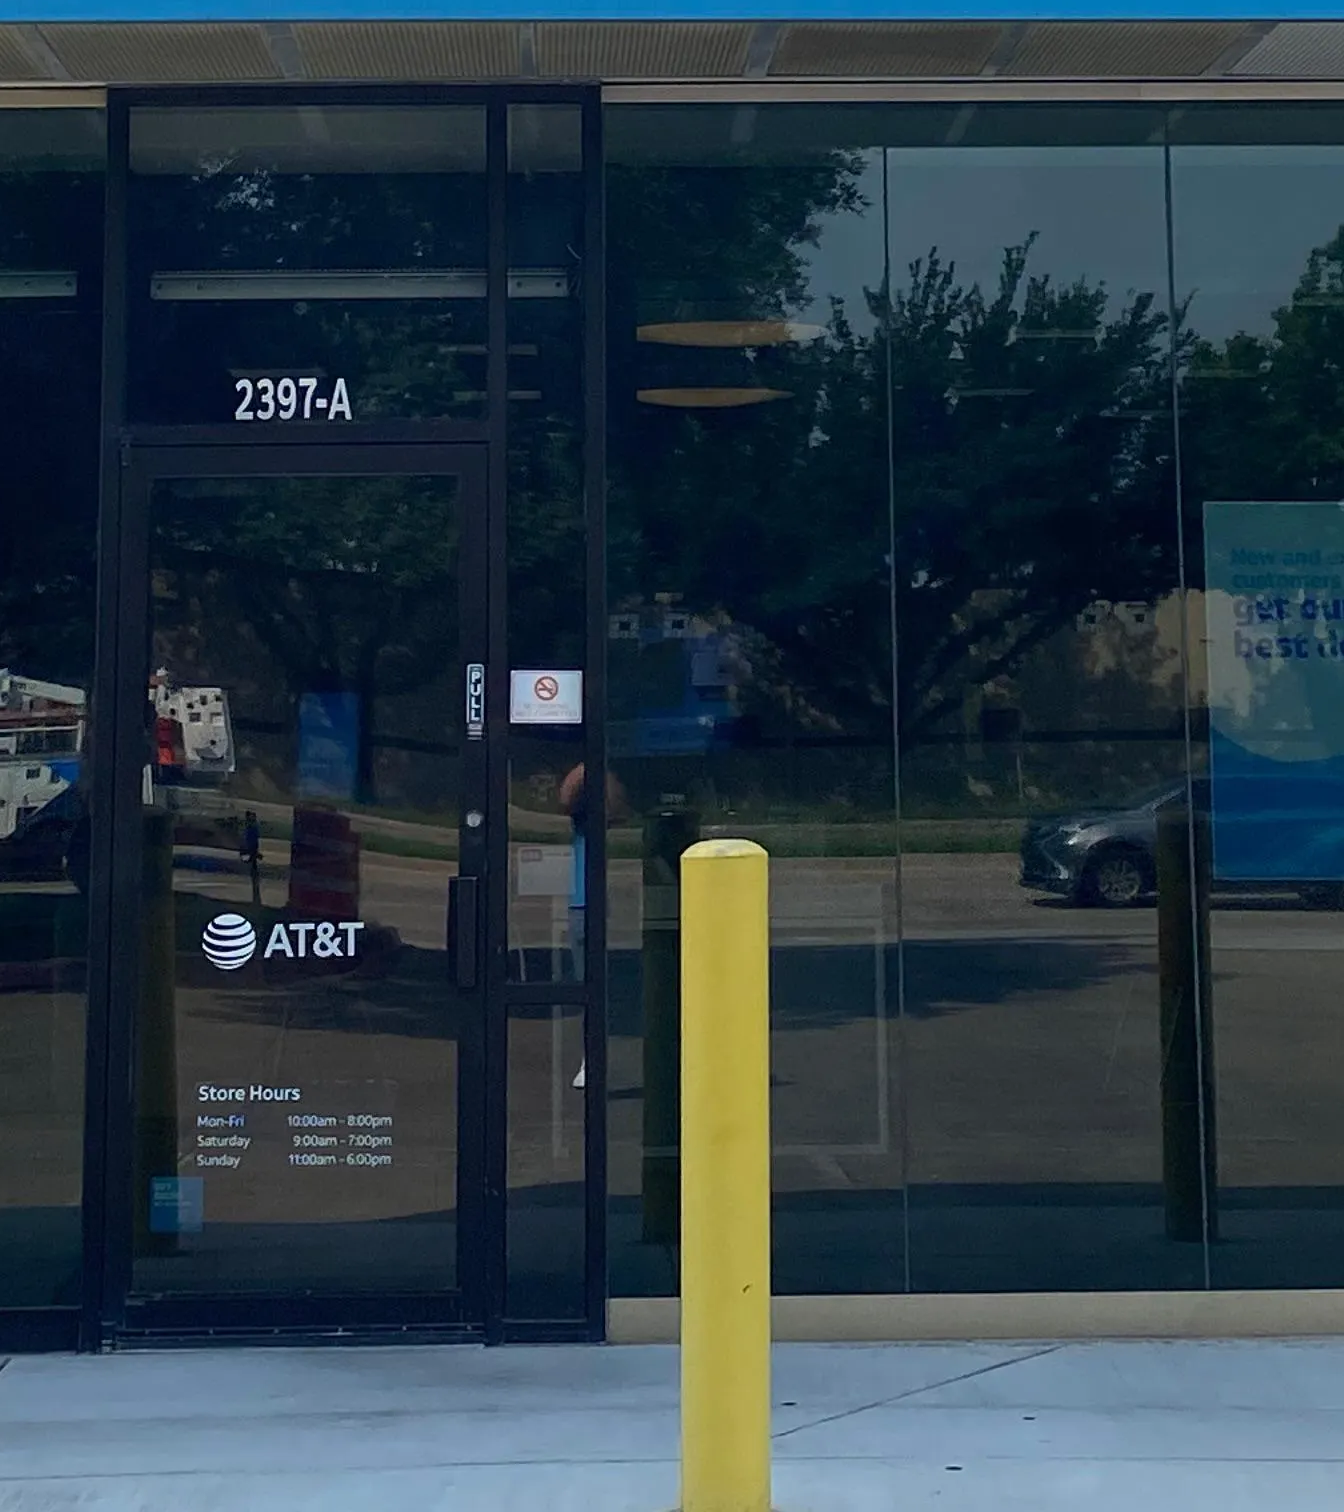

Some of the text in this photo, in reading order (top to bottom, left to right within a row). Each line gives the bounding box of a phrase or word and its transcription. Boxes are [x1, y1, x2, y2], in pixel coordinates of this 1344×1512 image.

[234, 377, 352, 421] 2397-A
[1283, 549, 1321, 566] and
[1233, 596, 1291, 626] get
[1234, 629, 1309, 659] best
[469, 670, 483, 722] PULL
[263, 921, 365, 958] AT&T
[197, 1085, 301, 1102] Store Hours
[196, 1114, 244, 1128] Mon-Fri
[287, 1114, 337, 1127] 10:00am
[347, 1114, 393, 1129] 8:00pm
[196, 1134, 251, 1150] Saturday
[292, 1135, 338, 1148] 9:00am
[347, 1135, 393, 1150] 7:00pm
[196, 1153, 241, 1169] Sunday
[288, 1154, 337, 1167] 11:00am
[346, 1154, 392, 1169] 6:00pm
